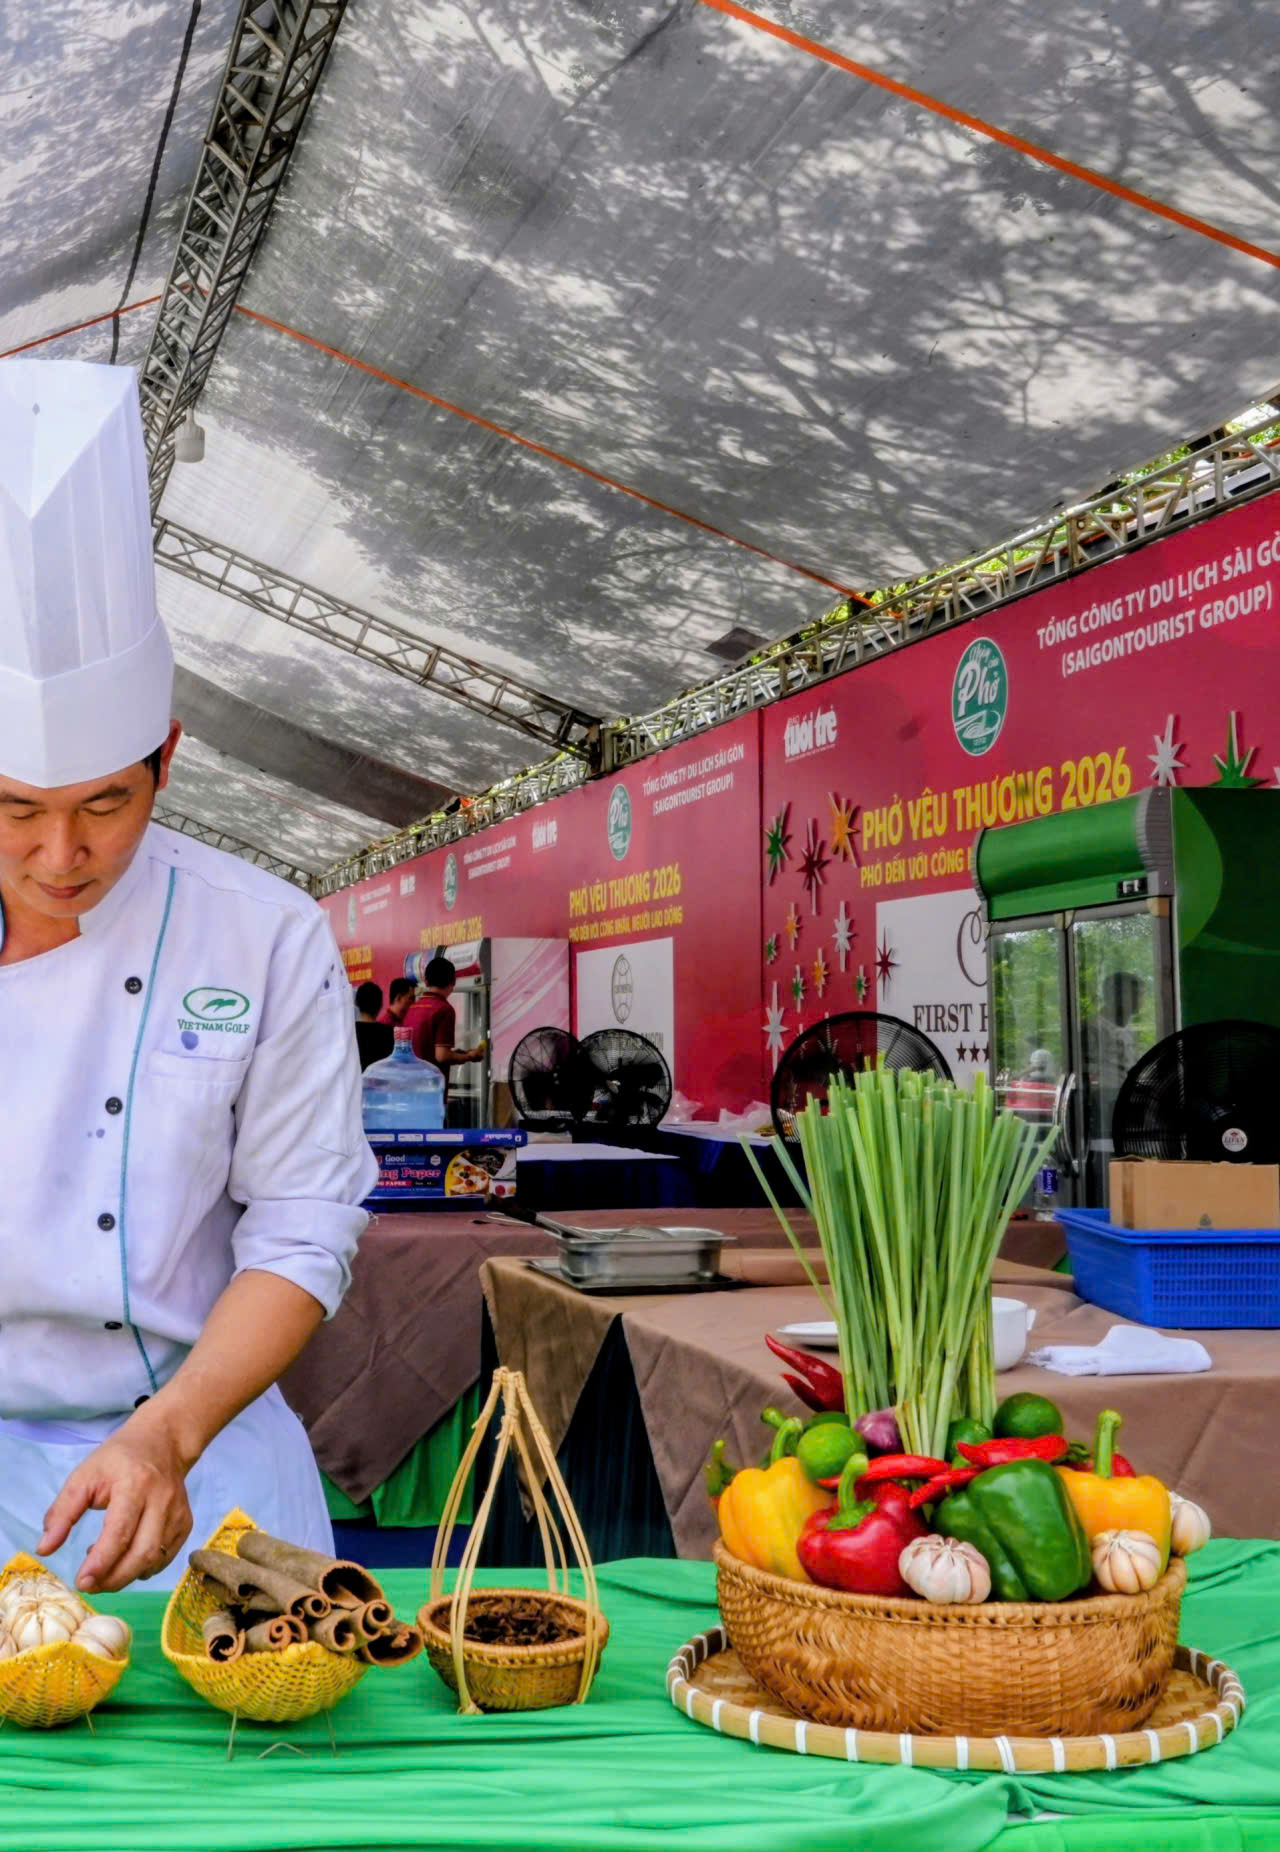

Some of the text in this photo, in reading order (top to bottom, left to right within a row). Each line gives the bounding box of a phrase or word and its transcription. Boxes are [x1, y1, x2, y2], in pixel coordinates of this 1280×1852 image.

[1037, 530, 1280, 649] TỔNG CÔNG TY DU LỊCH SÀI GÒ
[1061, 580, 1272, 678] (SAIGONTOURIST GROUP)
[862, 747, 1132, 851] PHỞ YÊU THƯƠNG 2026
[653, 862, 682, 901] 2026
[861, 858, 882, 888] PHỞ
[885, 852, 905, 885] ĐẾN
[931, 846, 964, 877] CÔNG
[177, 1019, 250, 1034] VIETNAM GOLF
[913, 1003, 973, 1032] FIRST
[385, 1154, 405, 1163] Good
